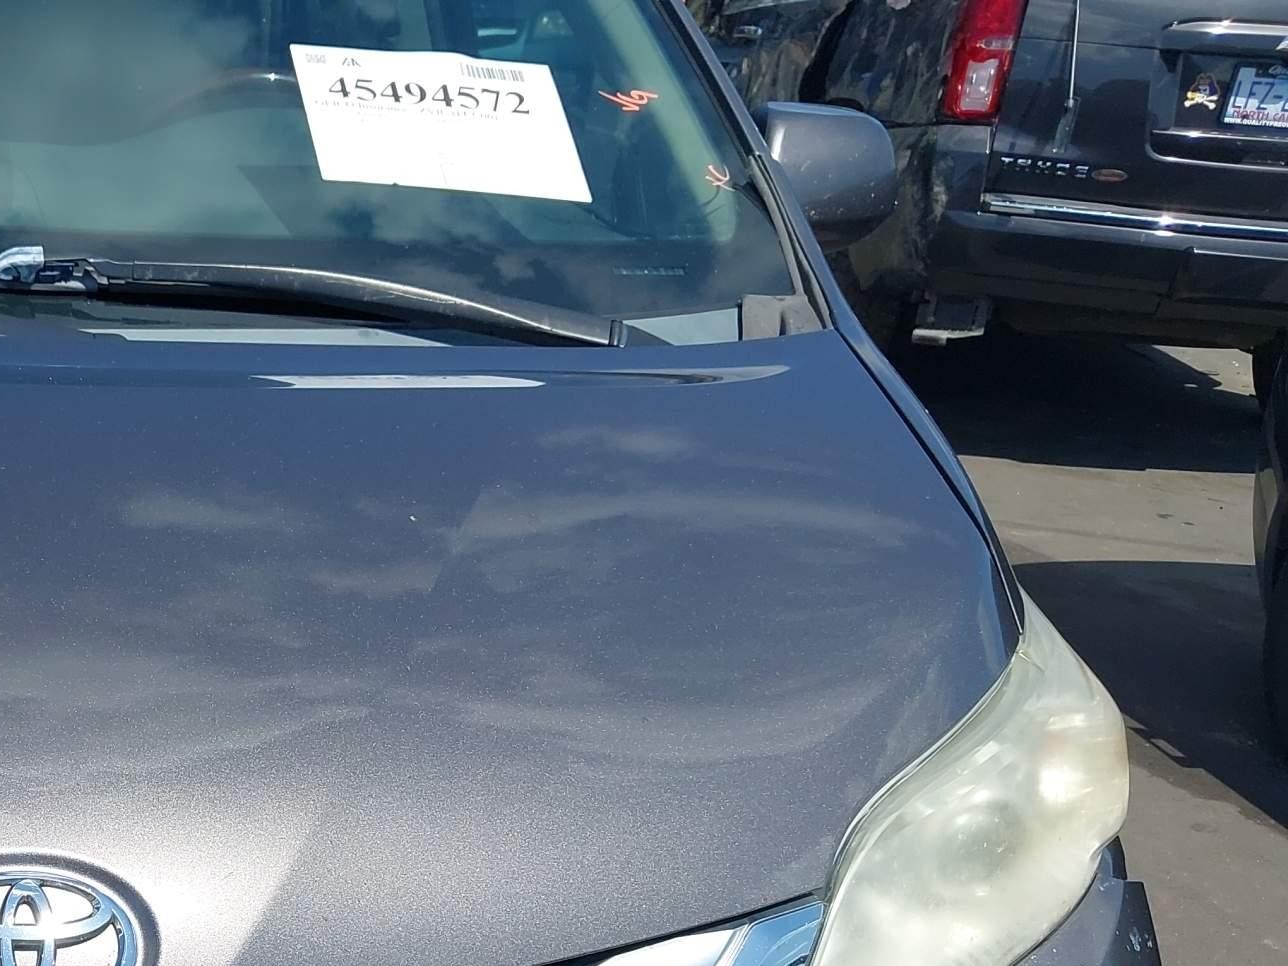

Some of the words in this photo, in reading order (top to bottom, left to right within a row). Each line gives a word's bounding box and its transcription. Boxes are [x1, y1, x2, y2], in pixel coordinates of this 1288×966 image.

[328, 76, 530, 116] 45494572
[1232, 110, 1270, 121] NORTH
[1272, 112, 1288, 122] CA
